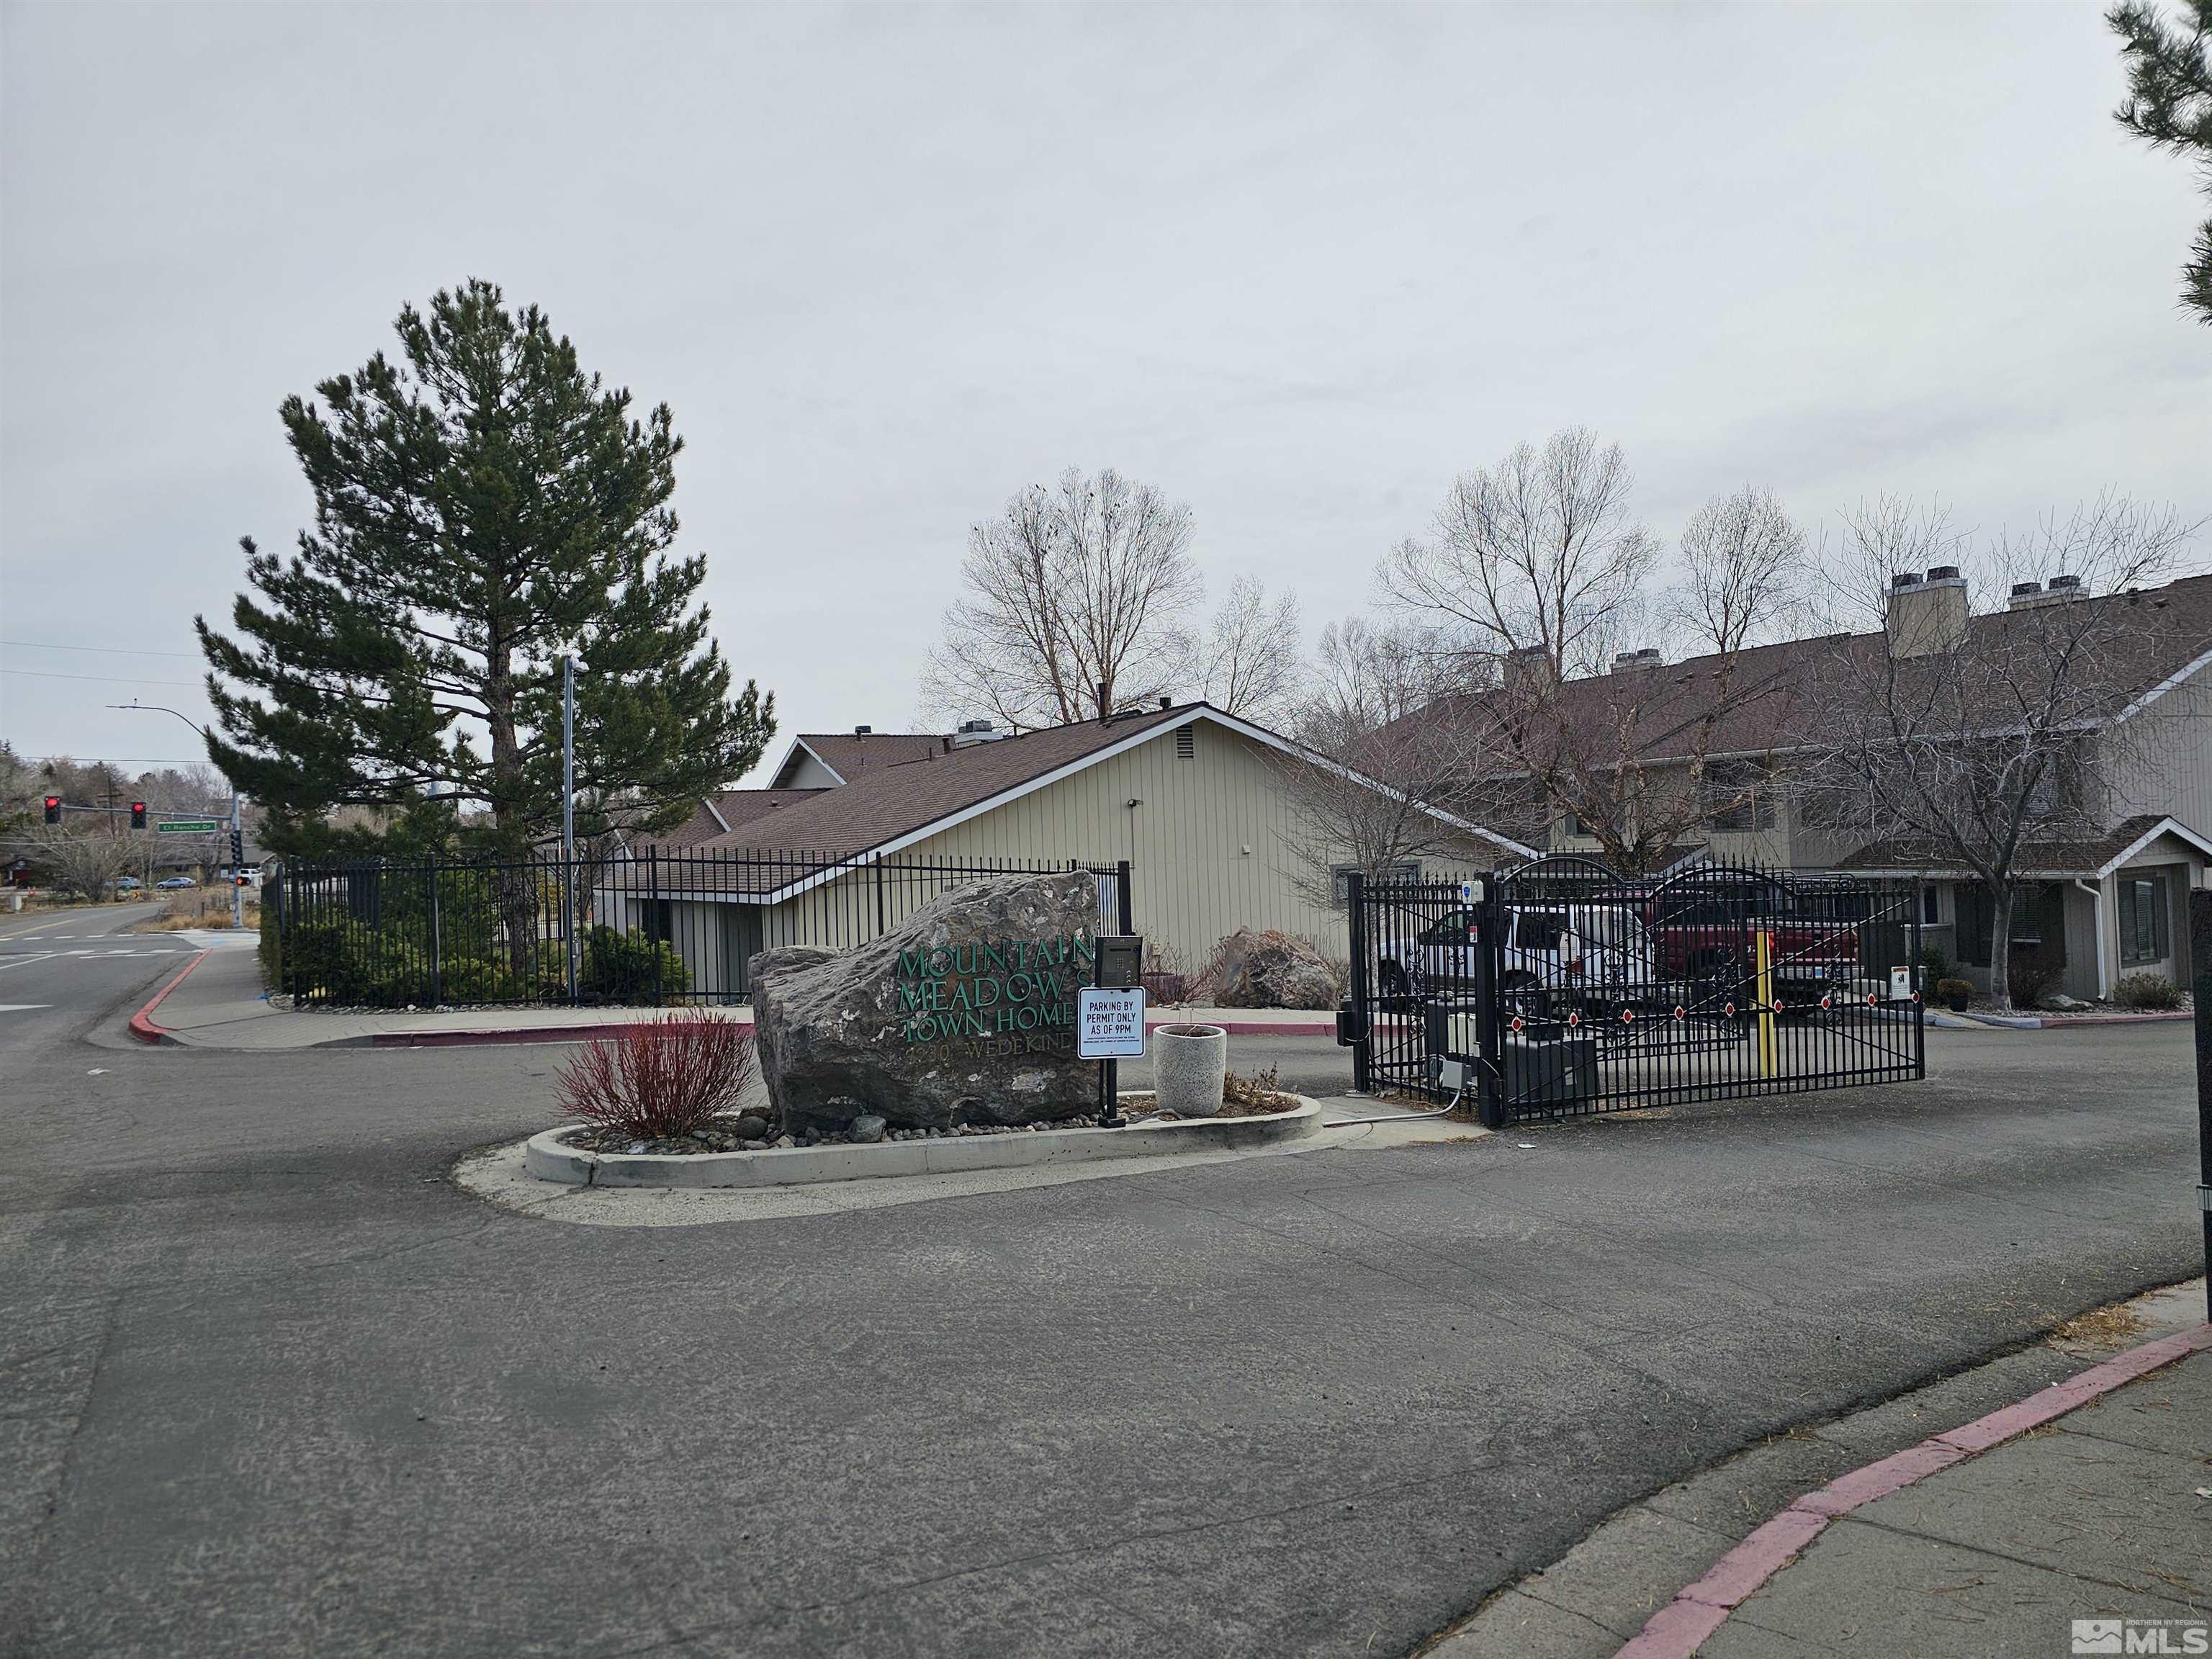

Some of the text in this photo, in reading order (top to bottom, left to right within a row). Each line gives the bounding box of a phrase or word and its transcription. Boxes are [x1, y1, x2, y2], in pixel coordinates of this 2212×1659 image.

[896, 935, 1094, 979] MOUNTAIN
[1089, 1001, 1134, 1012] PARKING BY
[1087, 1012, 1136, 1023] PERMIT ONLY
[899, 1009, 984, 1043] TOWN
[1091, 1024, 1131, 1035] AS OF 9PM
